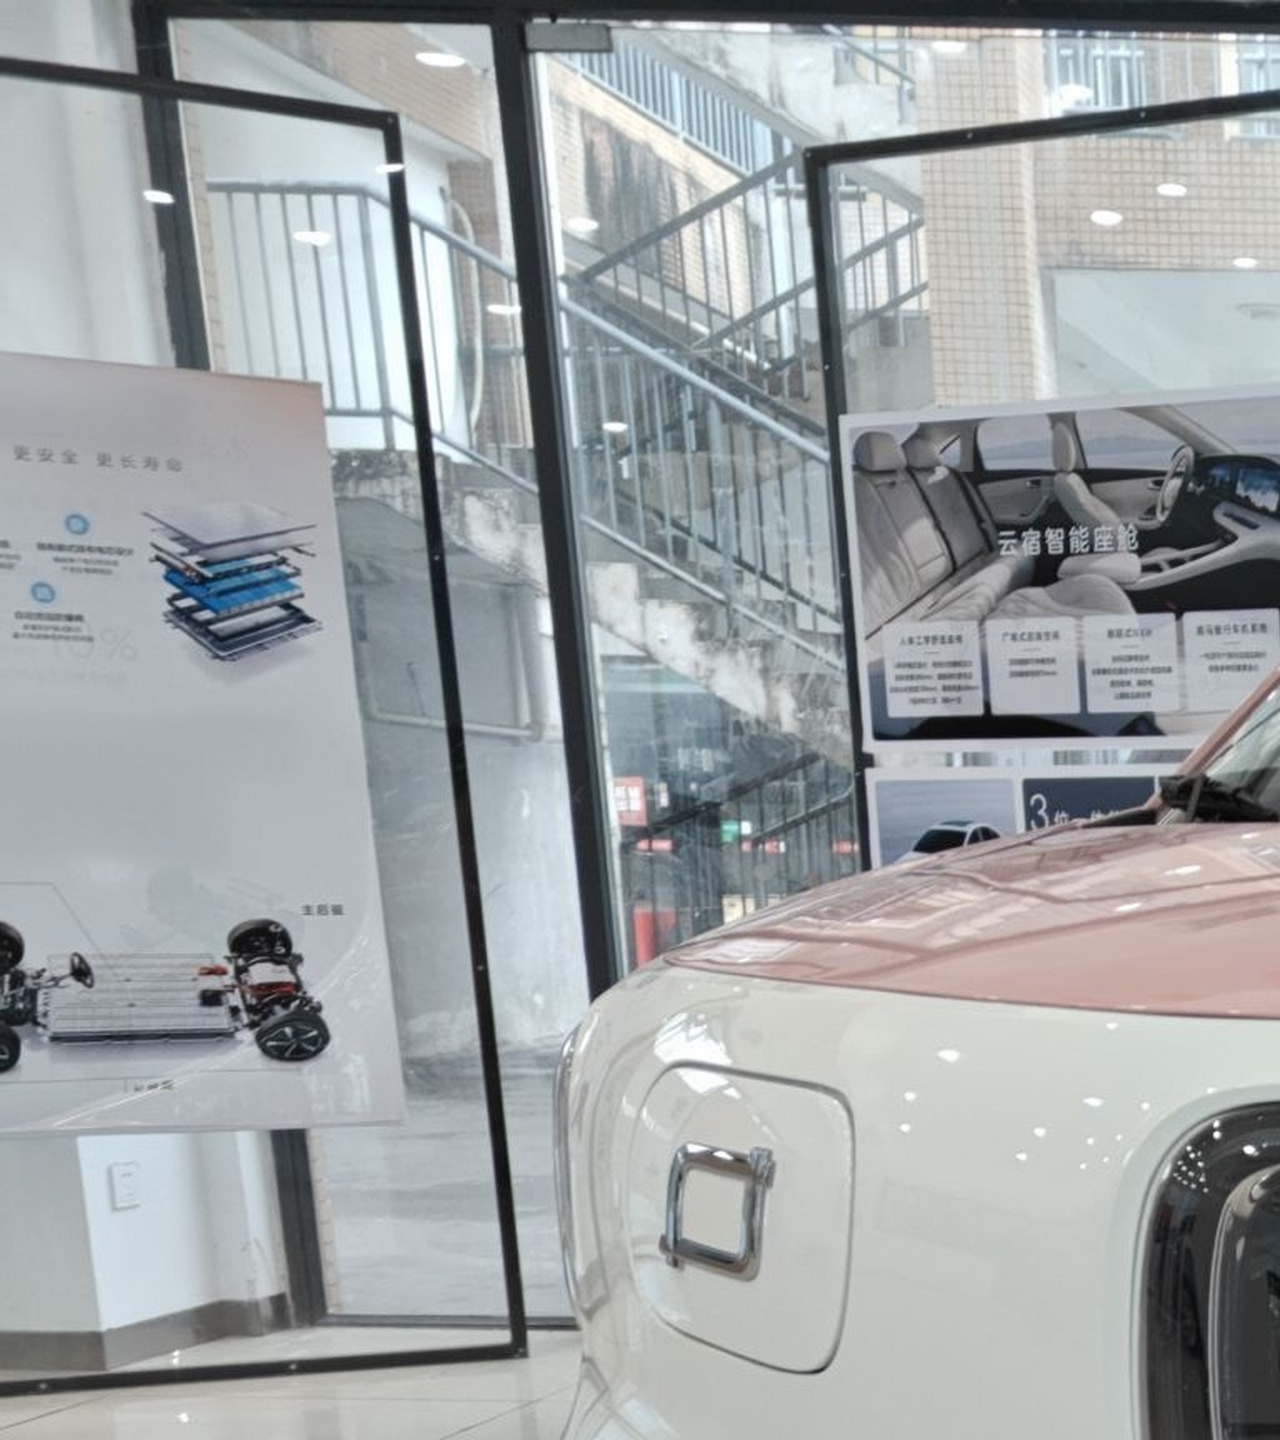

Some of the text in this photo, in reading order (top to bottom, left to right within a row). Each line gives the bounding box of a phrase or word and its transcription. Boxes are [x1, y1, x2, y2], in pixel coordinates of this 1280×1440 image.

[997, 521, 1140, 557] 云宿智能座舱
